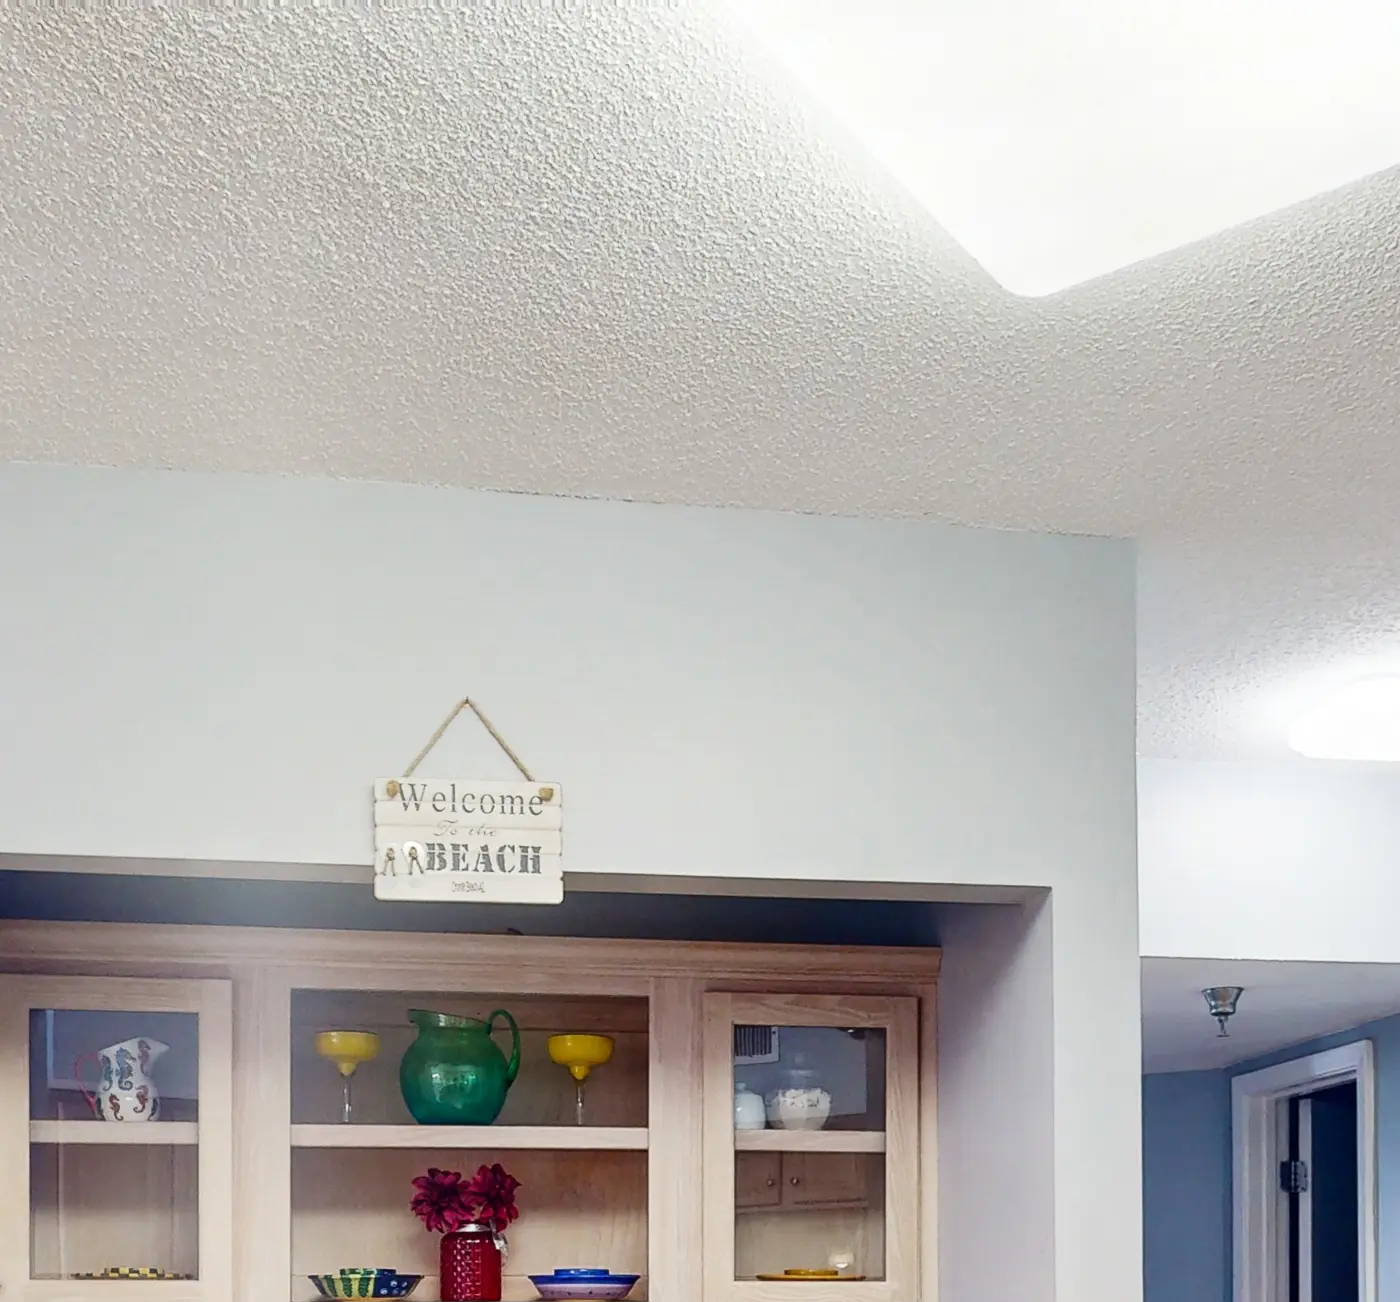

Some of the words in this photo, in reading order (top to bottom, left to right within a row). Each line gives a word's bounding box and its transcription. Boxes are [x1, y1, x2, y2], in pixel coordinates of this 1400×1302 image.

[399, 783, 543, 816] Welcome
[433, 819, 458, 837] To
[425, 843, 542, 874] BEACH
